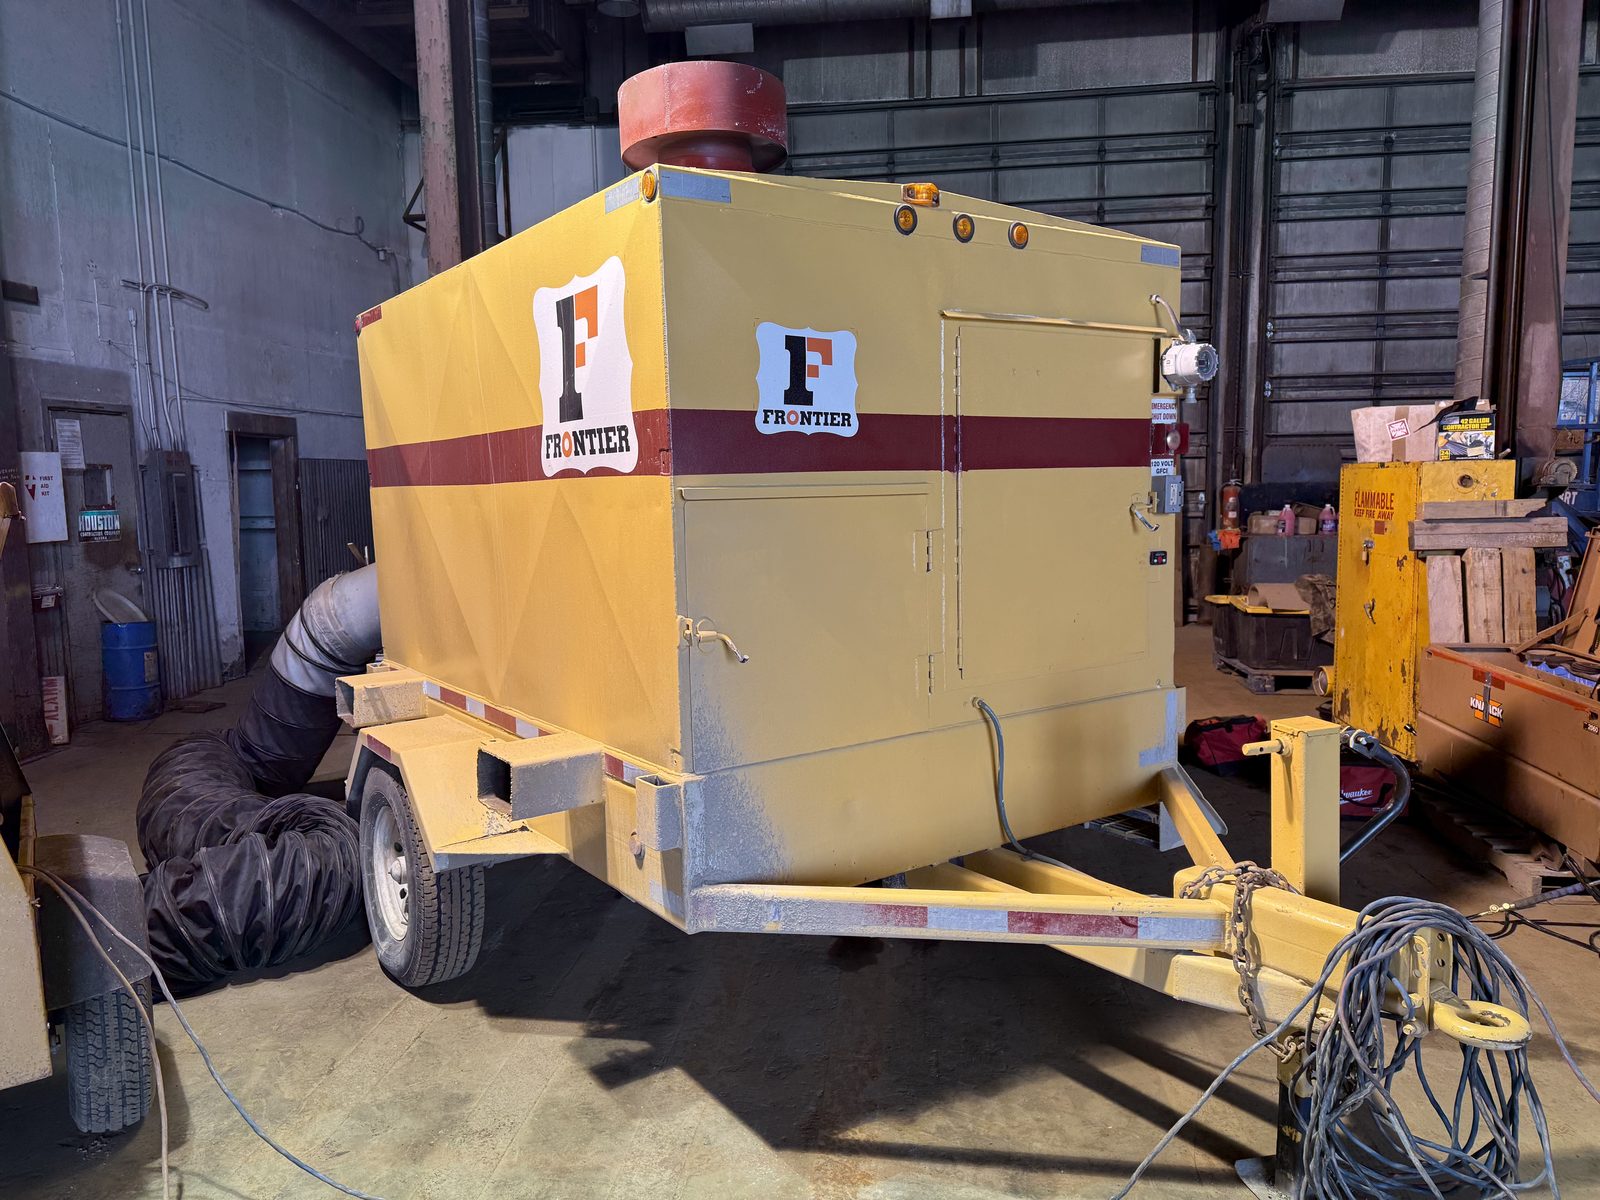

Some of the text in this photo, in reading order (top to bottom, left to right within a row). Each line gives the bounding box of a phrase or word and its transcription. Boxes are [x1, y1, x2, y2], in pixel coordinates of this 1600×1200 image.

[762, 408, 852, 427] FRONTIER
[545, 424, 631, 459] FRONTIER
[1354, 490, 1394, 510] FLAMMABLE
[79, 515, 120, 531] HOUSTON
[1354, 508, 1394, 520] KEEP FIRE AWAY
